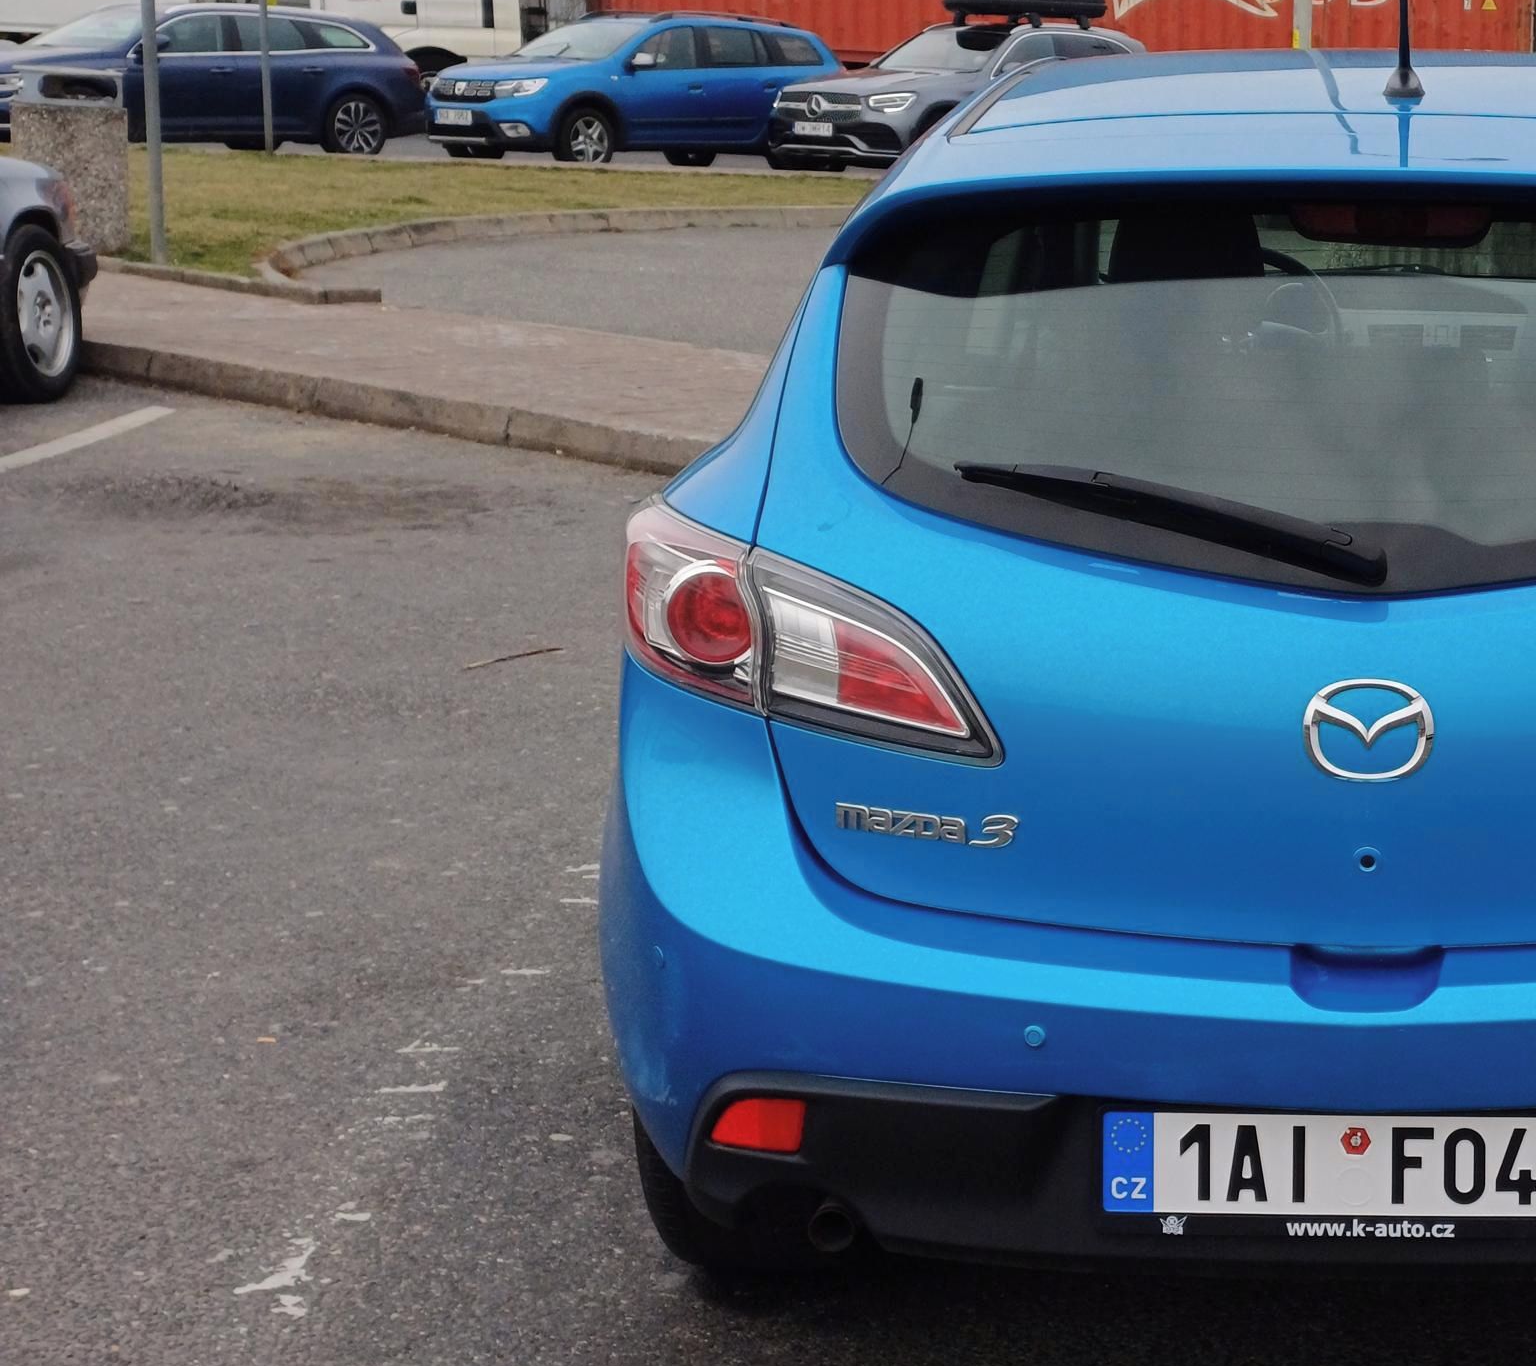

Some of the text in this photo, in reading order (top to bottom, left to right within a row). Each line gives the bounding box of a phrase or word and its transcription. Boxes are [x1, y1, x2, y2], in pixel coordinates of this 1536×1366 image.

[968, 814, 1020, 849] 3
[1180, 1124, 1306, 1203] 1AI
[1111, 1177, 1148, 1200] CZ
[1286, 1219, 1456, 1240] www.k-auto.cz
